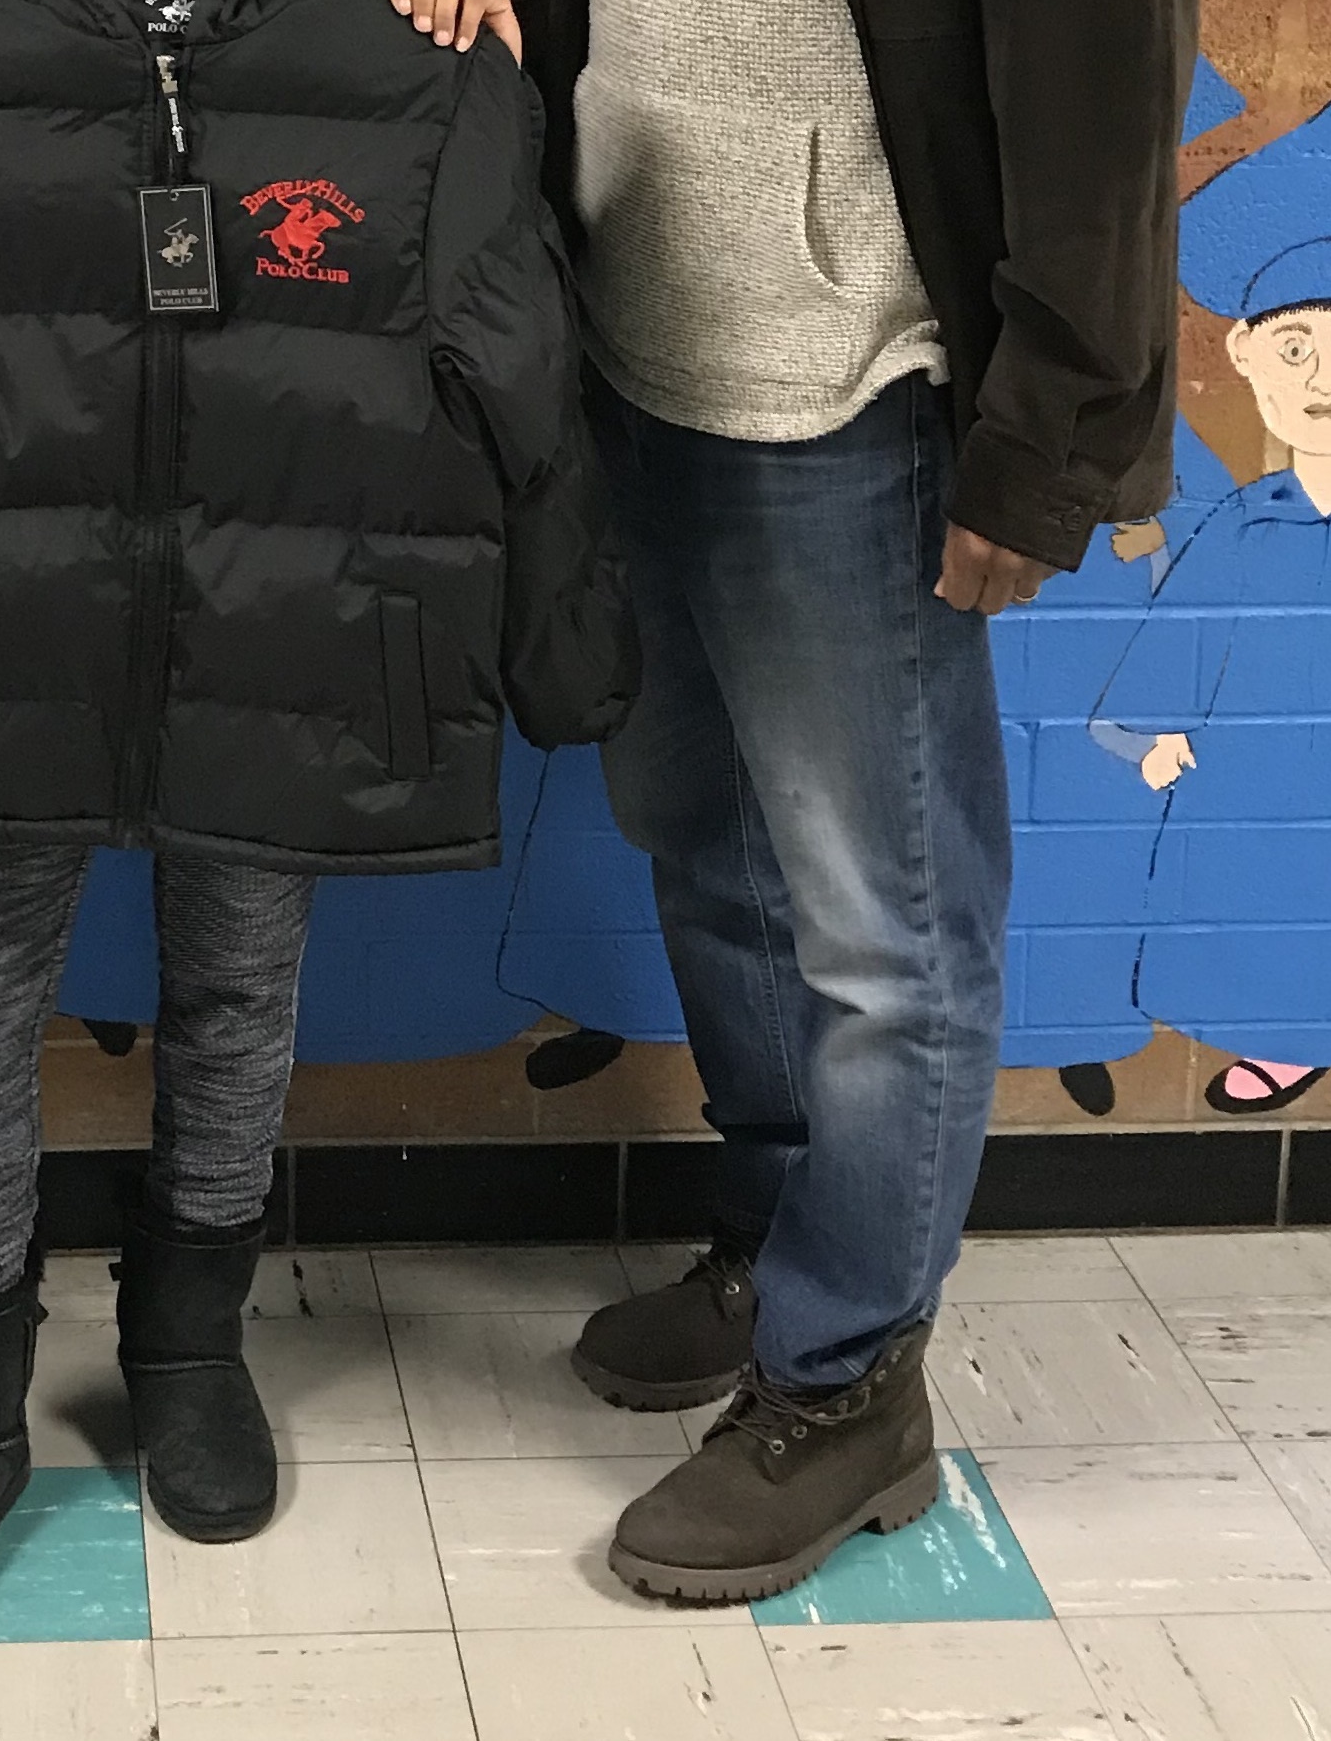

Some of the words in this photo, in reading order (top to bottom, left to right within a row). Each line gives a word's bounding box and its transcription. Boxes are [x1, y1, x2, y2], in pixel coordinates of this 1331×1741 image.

[147, 22, 178, 34] POLO
[239, 179, 314, 216] BEVERLY
[314, 179, 366, 223] HILLS
[302, 262, 350, 284] CLUB
